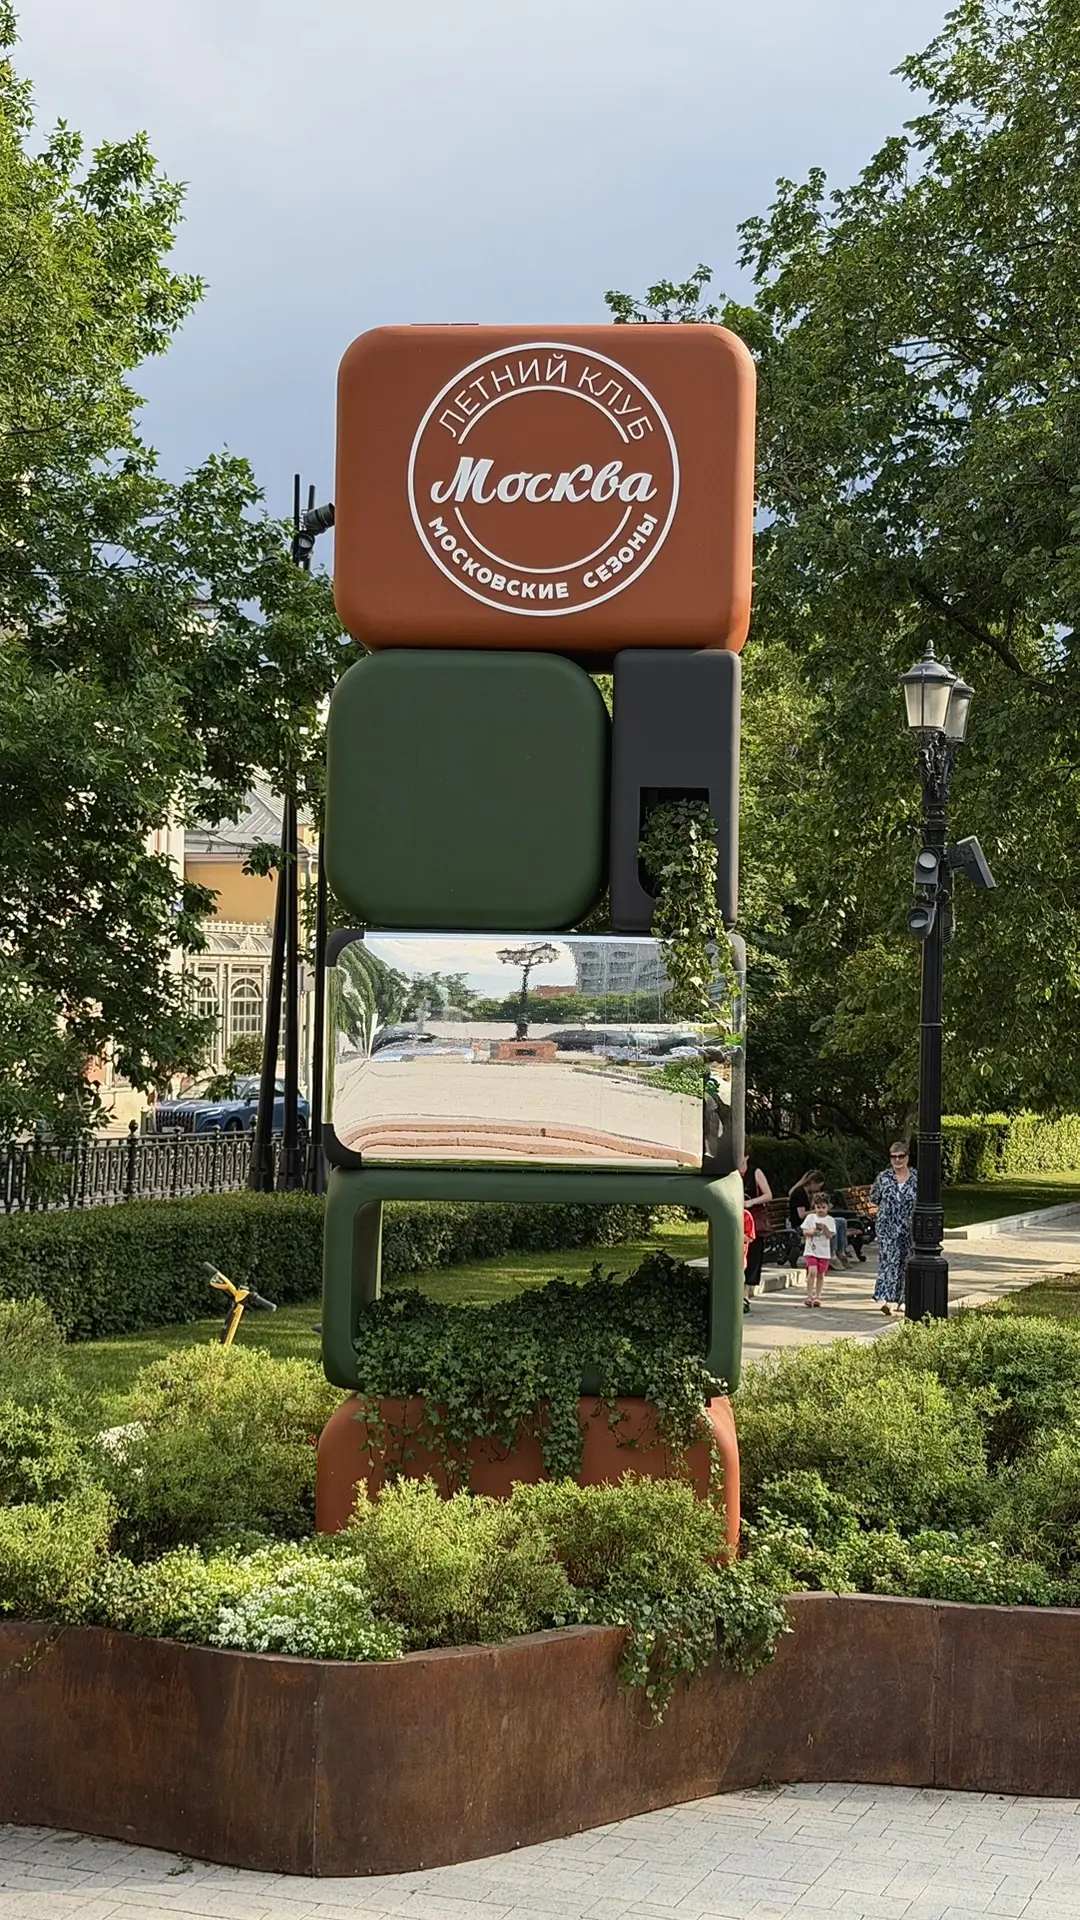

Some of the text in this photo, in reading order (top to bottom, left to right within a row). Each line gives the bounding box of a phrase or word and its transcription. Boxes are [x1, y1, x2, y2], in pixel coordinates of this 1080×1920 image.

[438, 353, 653, 441] ЛЕТНИЙ КЛУБ
[430, 456, 658, 504] Москва
[428, 513, 658, 599] МОСКОВСКИЕ СЕЗОНЫ
